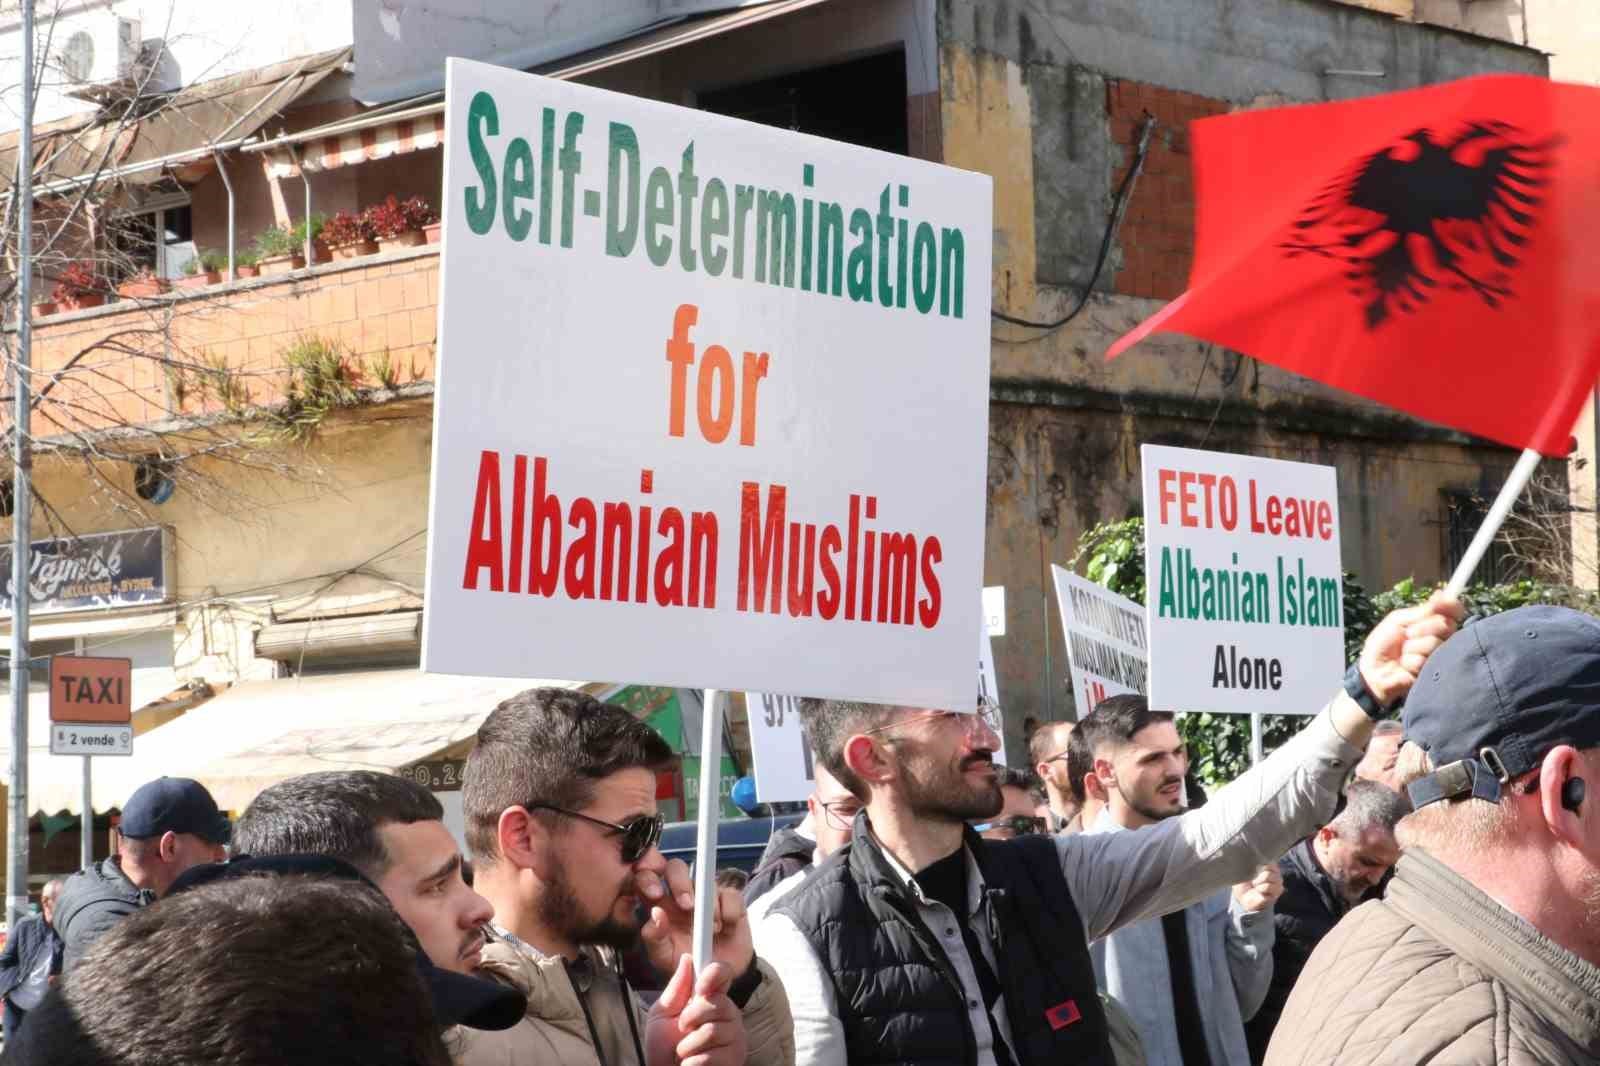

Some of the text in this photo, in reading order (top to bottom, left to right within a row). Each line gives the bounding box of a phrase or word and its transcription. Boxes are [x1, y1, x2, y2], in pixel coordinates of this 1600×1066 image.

[464, 90, 966, 320] Self-Determination
[666, 304, 769, 447] for
[463, 451, 942, 630] Albanian Muslims
[1159, 469, 1333, 541] FETO Leave
[1158, 547, 1341, 627] Albanian Islam
[60, 675, 123, 704] TAXI
[1213, 645, 1282, 690] Alone
[70, 733, 116, 746] 2 vende
